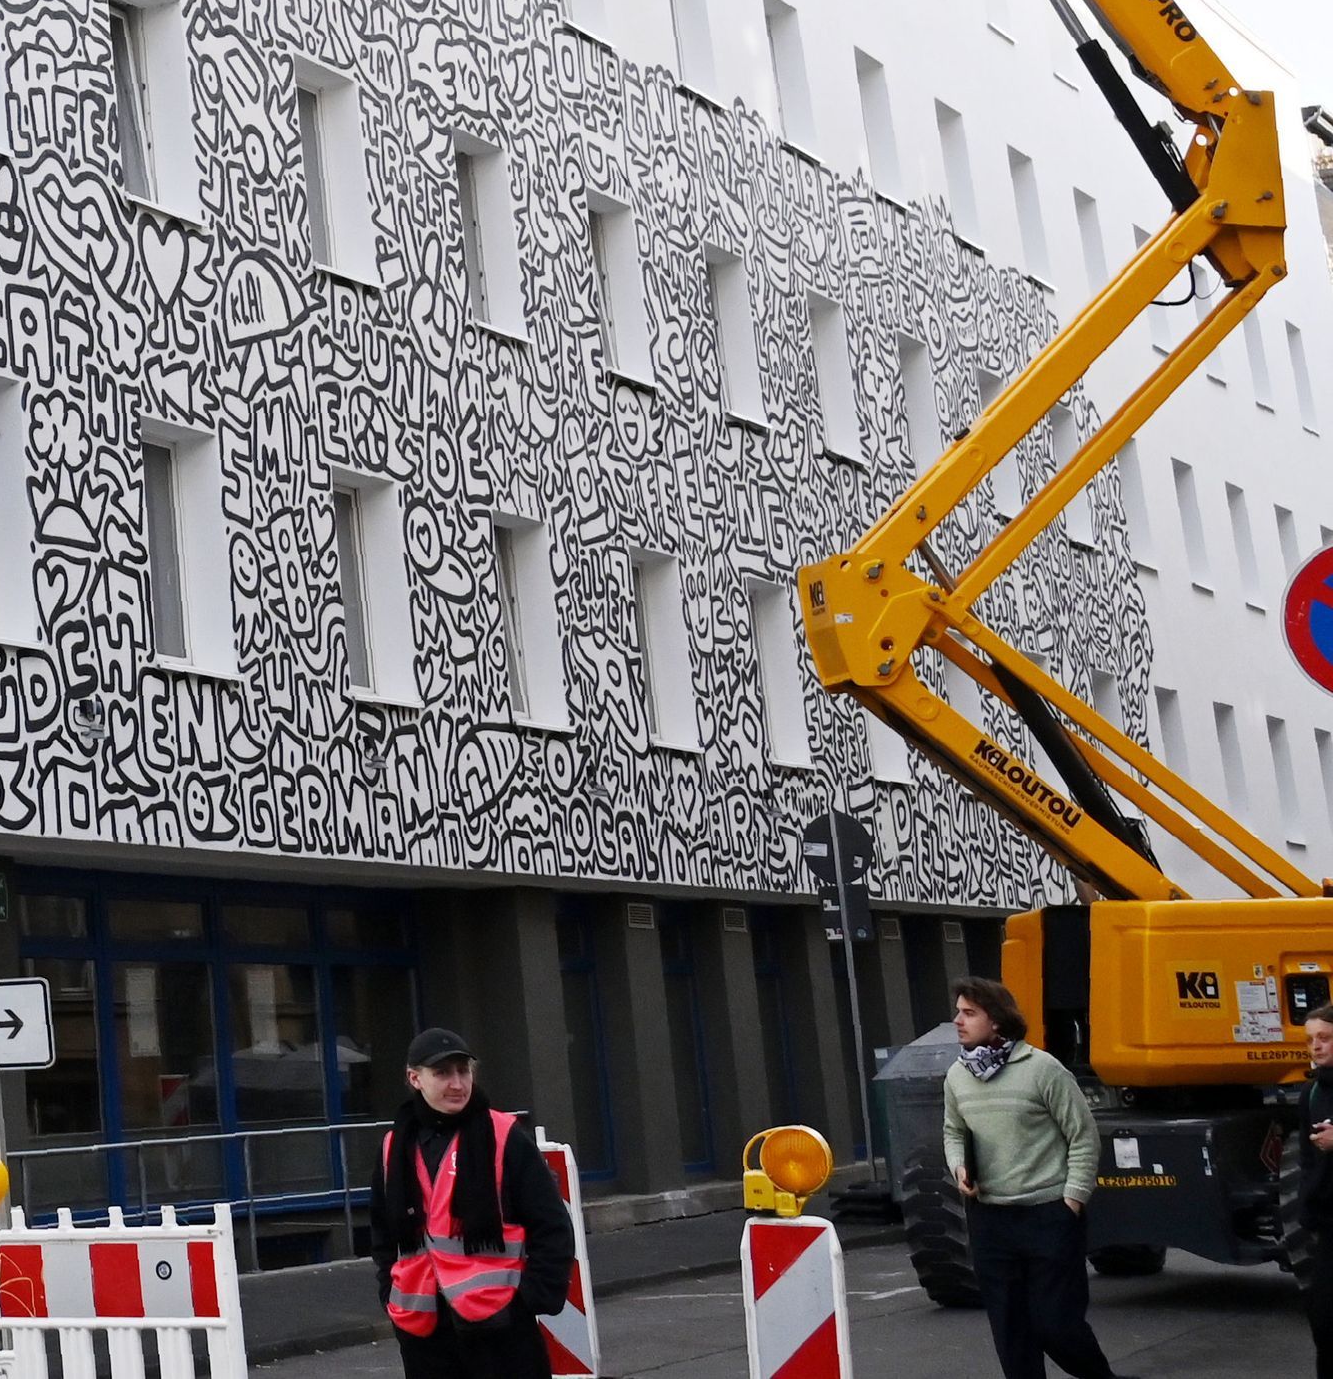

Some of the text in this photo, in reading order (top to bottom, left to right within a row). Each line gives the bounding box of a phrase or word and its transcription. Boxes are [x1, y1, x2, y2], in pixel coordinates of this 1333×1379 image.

[360, 36, 393, 90] PLAY
[459, 59, 478, 102] YO
[531, 19, 696, 170] COLOGNE
[200, 148, 311, 272] JECK
[739, 109, 835, 230] ALAAF
[240, 645, 331, 741] FUN
[553, 792, 658, 880] LOCAL
[707, 782, 771, 867] ART
[784, 781, 825, 820] FRÜNDE
